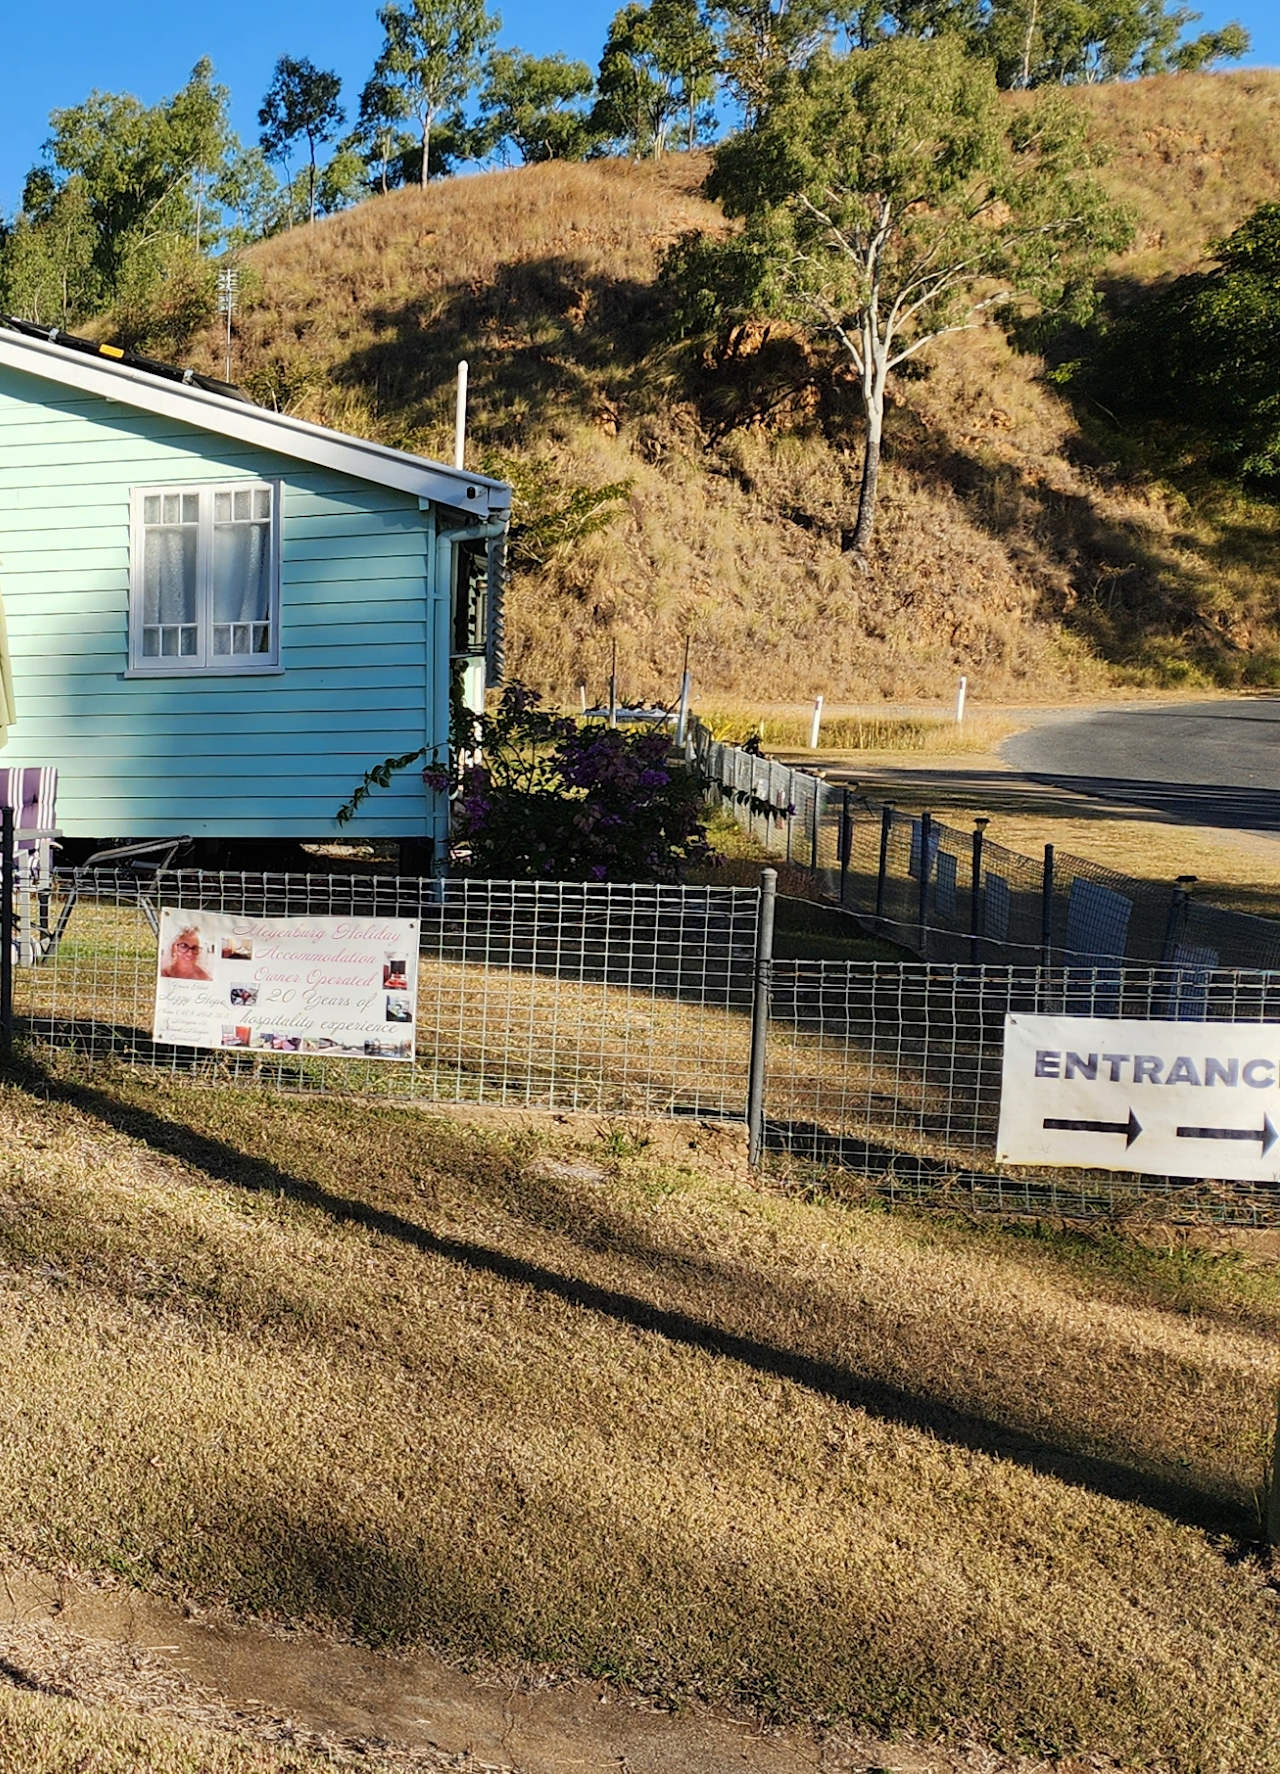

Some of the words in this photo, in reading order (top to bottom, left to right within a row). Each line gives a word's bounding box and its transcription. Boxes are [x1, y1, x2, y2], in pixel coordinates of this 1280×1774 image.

[232, 923, 326, 943] Meyenburg
[331, 922, 401, 943] Holiday
[254, 945, 377, 965] Accommodation
[253, 967, 299, 983] Owner
[306, 968, 378, 990] Operated
[266, 988, 296, 1003] 20
[302, 989, 350, 1010] Years
[355, 991, 378, 1013] of
[239, 1009, 314, 1029] hospitality
[320, 1018, 399, 1035] experience
[1035, 1050, 1280, 1088] ENTRANC
